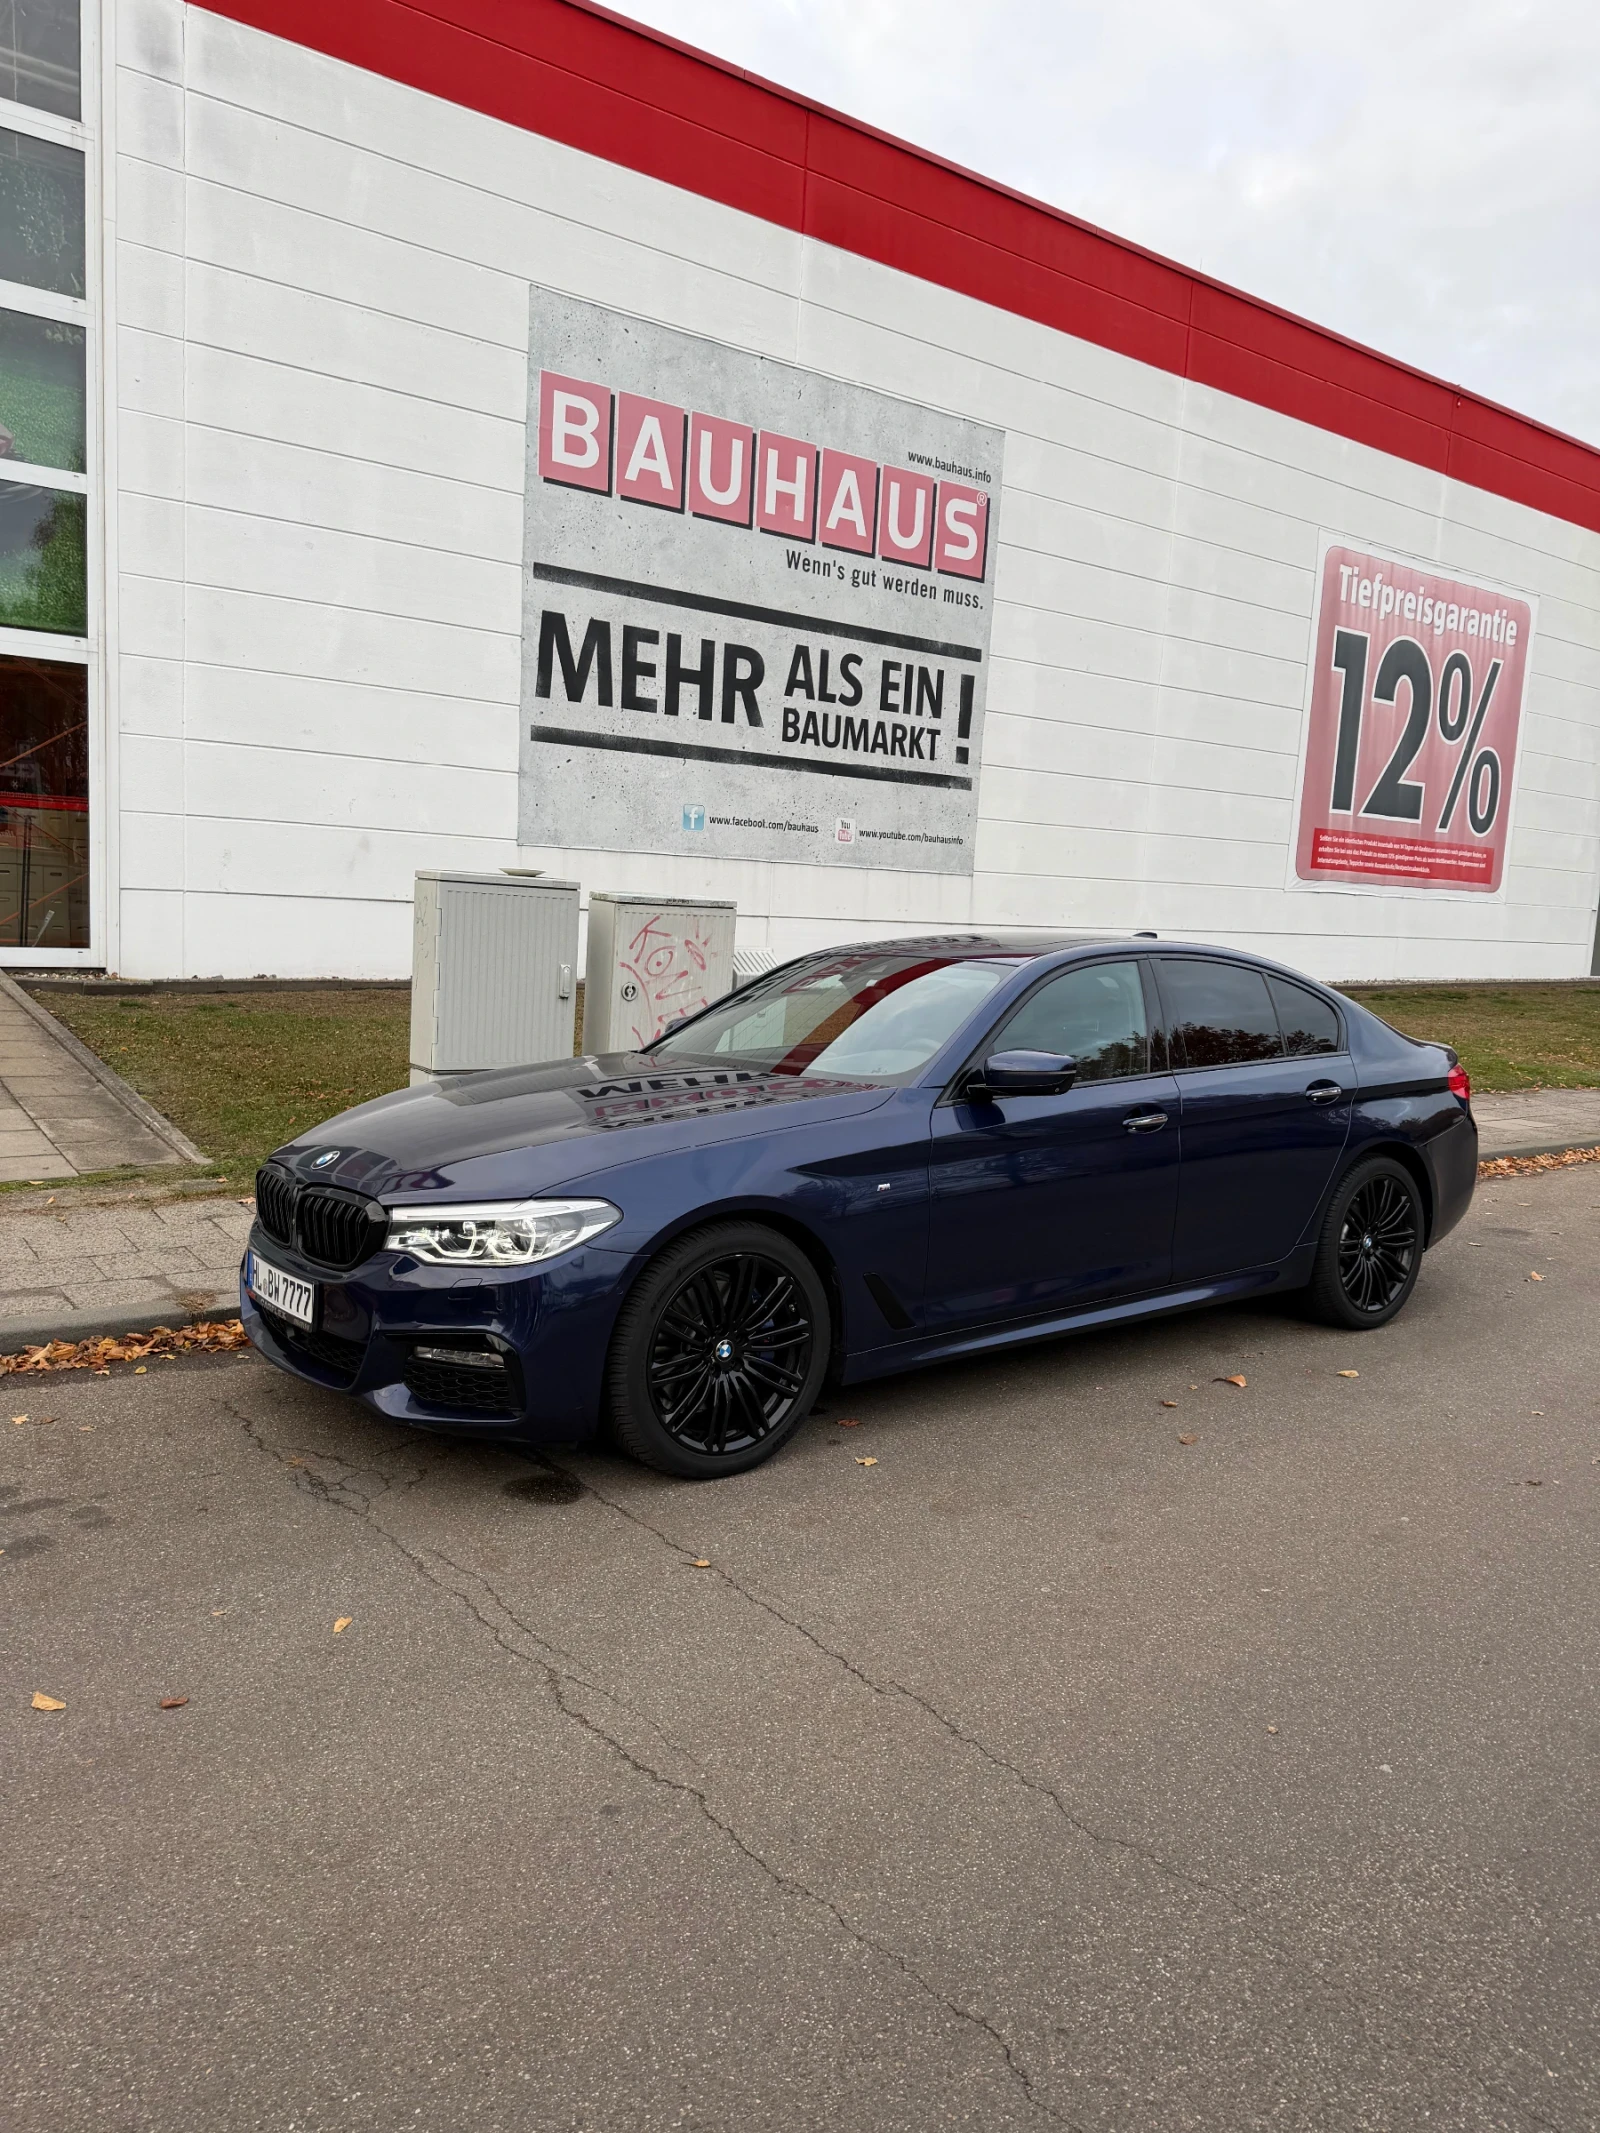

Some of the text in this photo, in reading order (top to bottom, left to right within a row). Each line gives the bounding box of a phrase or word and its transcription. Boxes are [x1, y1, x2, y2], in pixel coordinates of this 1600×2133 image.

[551, 389, 979, 561] BAUHAUS
[907, 451, 992, 484] www.bauhaus.info
[786, 549, 984, 610] Wenn's gut werden muss.
[1338, 564, 1518, 647] Tiefpreisgarantie
[535, 609, 765, 728] MEHR
[784, 644, 864, 707] ALS
[879, 659, 945, 720] EIN
[781, 707, 940, 762] BAUMARKT
[1329, 625, 1505, 838] 12%
[709, 816, 819, 834] www.facebook.com/bauhaus
[859, 829, 963, 845] www.youtube.com/bauhausinfo
[283, 1277, 311, 1317] 7777
